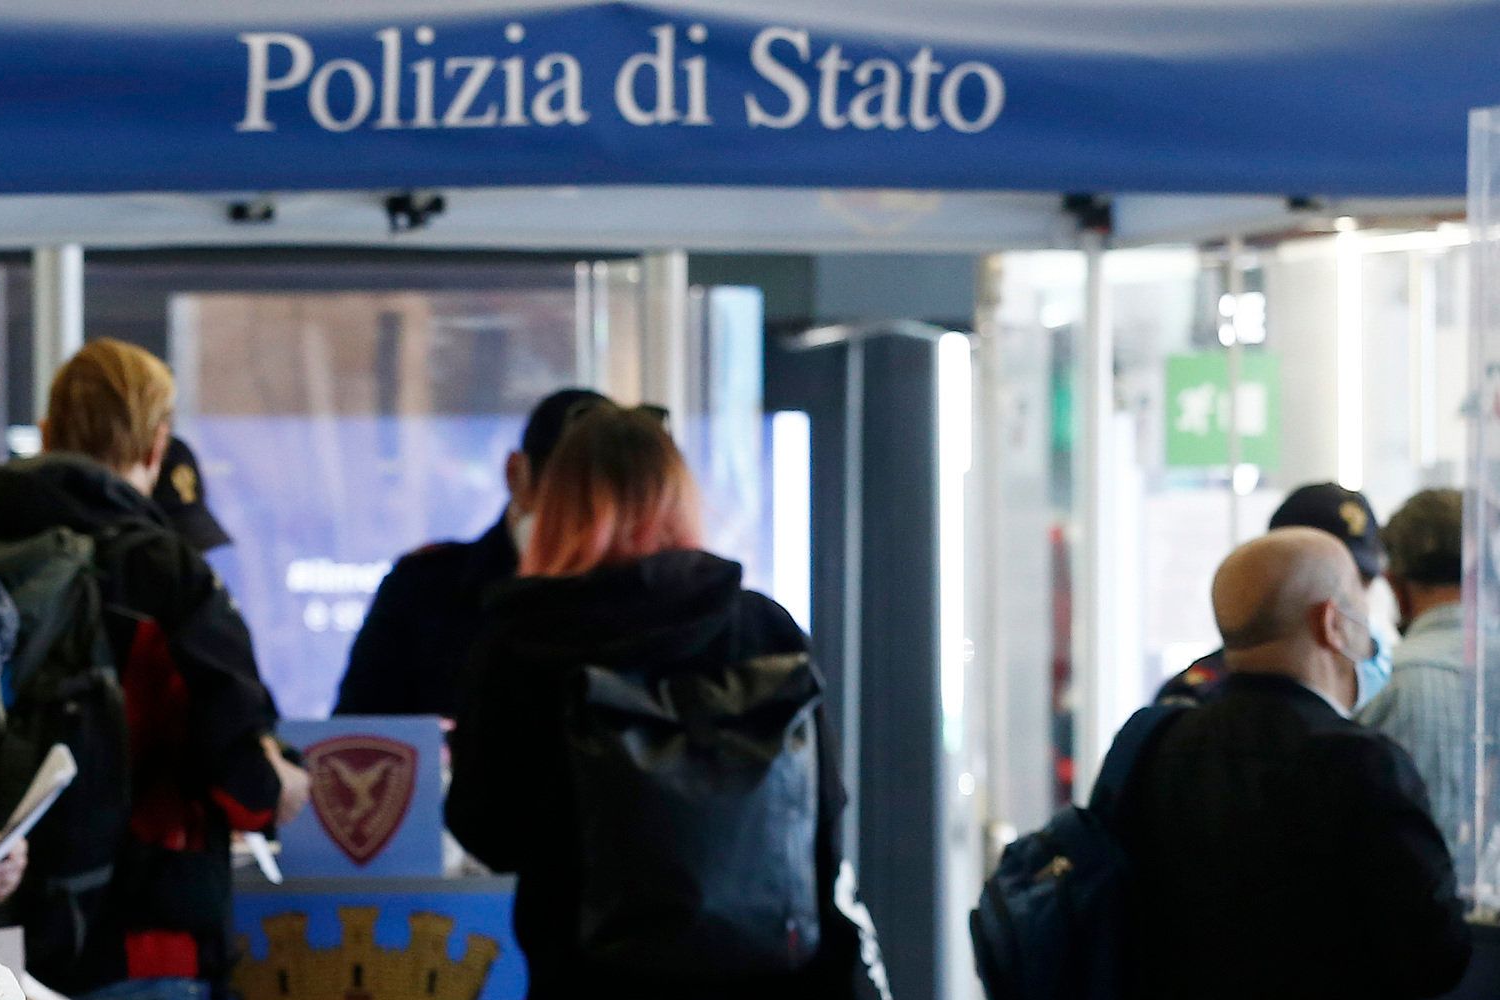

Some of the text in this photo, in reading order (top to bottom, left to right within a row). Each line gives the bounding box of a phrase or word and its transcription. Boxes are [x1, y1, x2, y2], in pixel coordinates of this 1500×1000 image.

[234, 24, 1005, 134] Polizia di Stato
